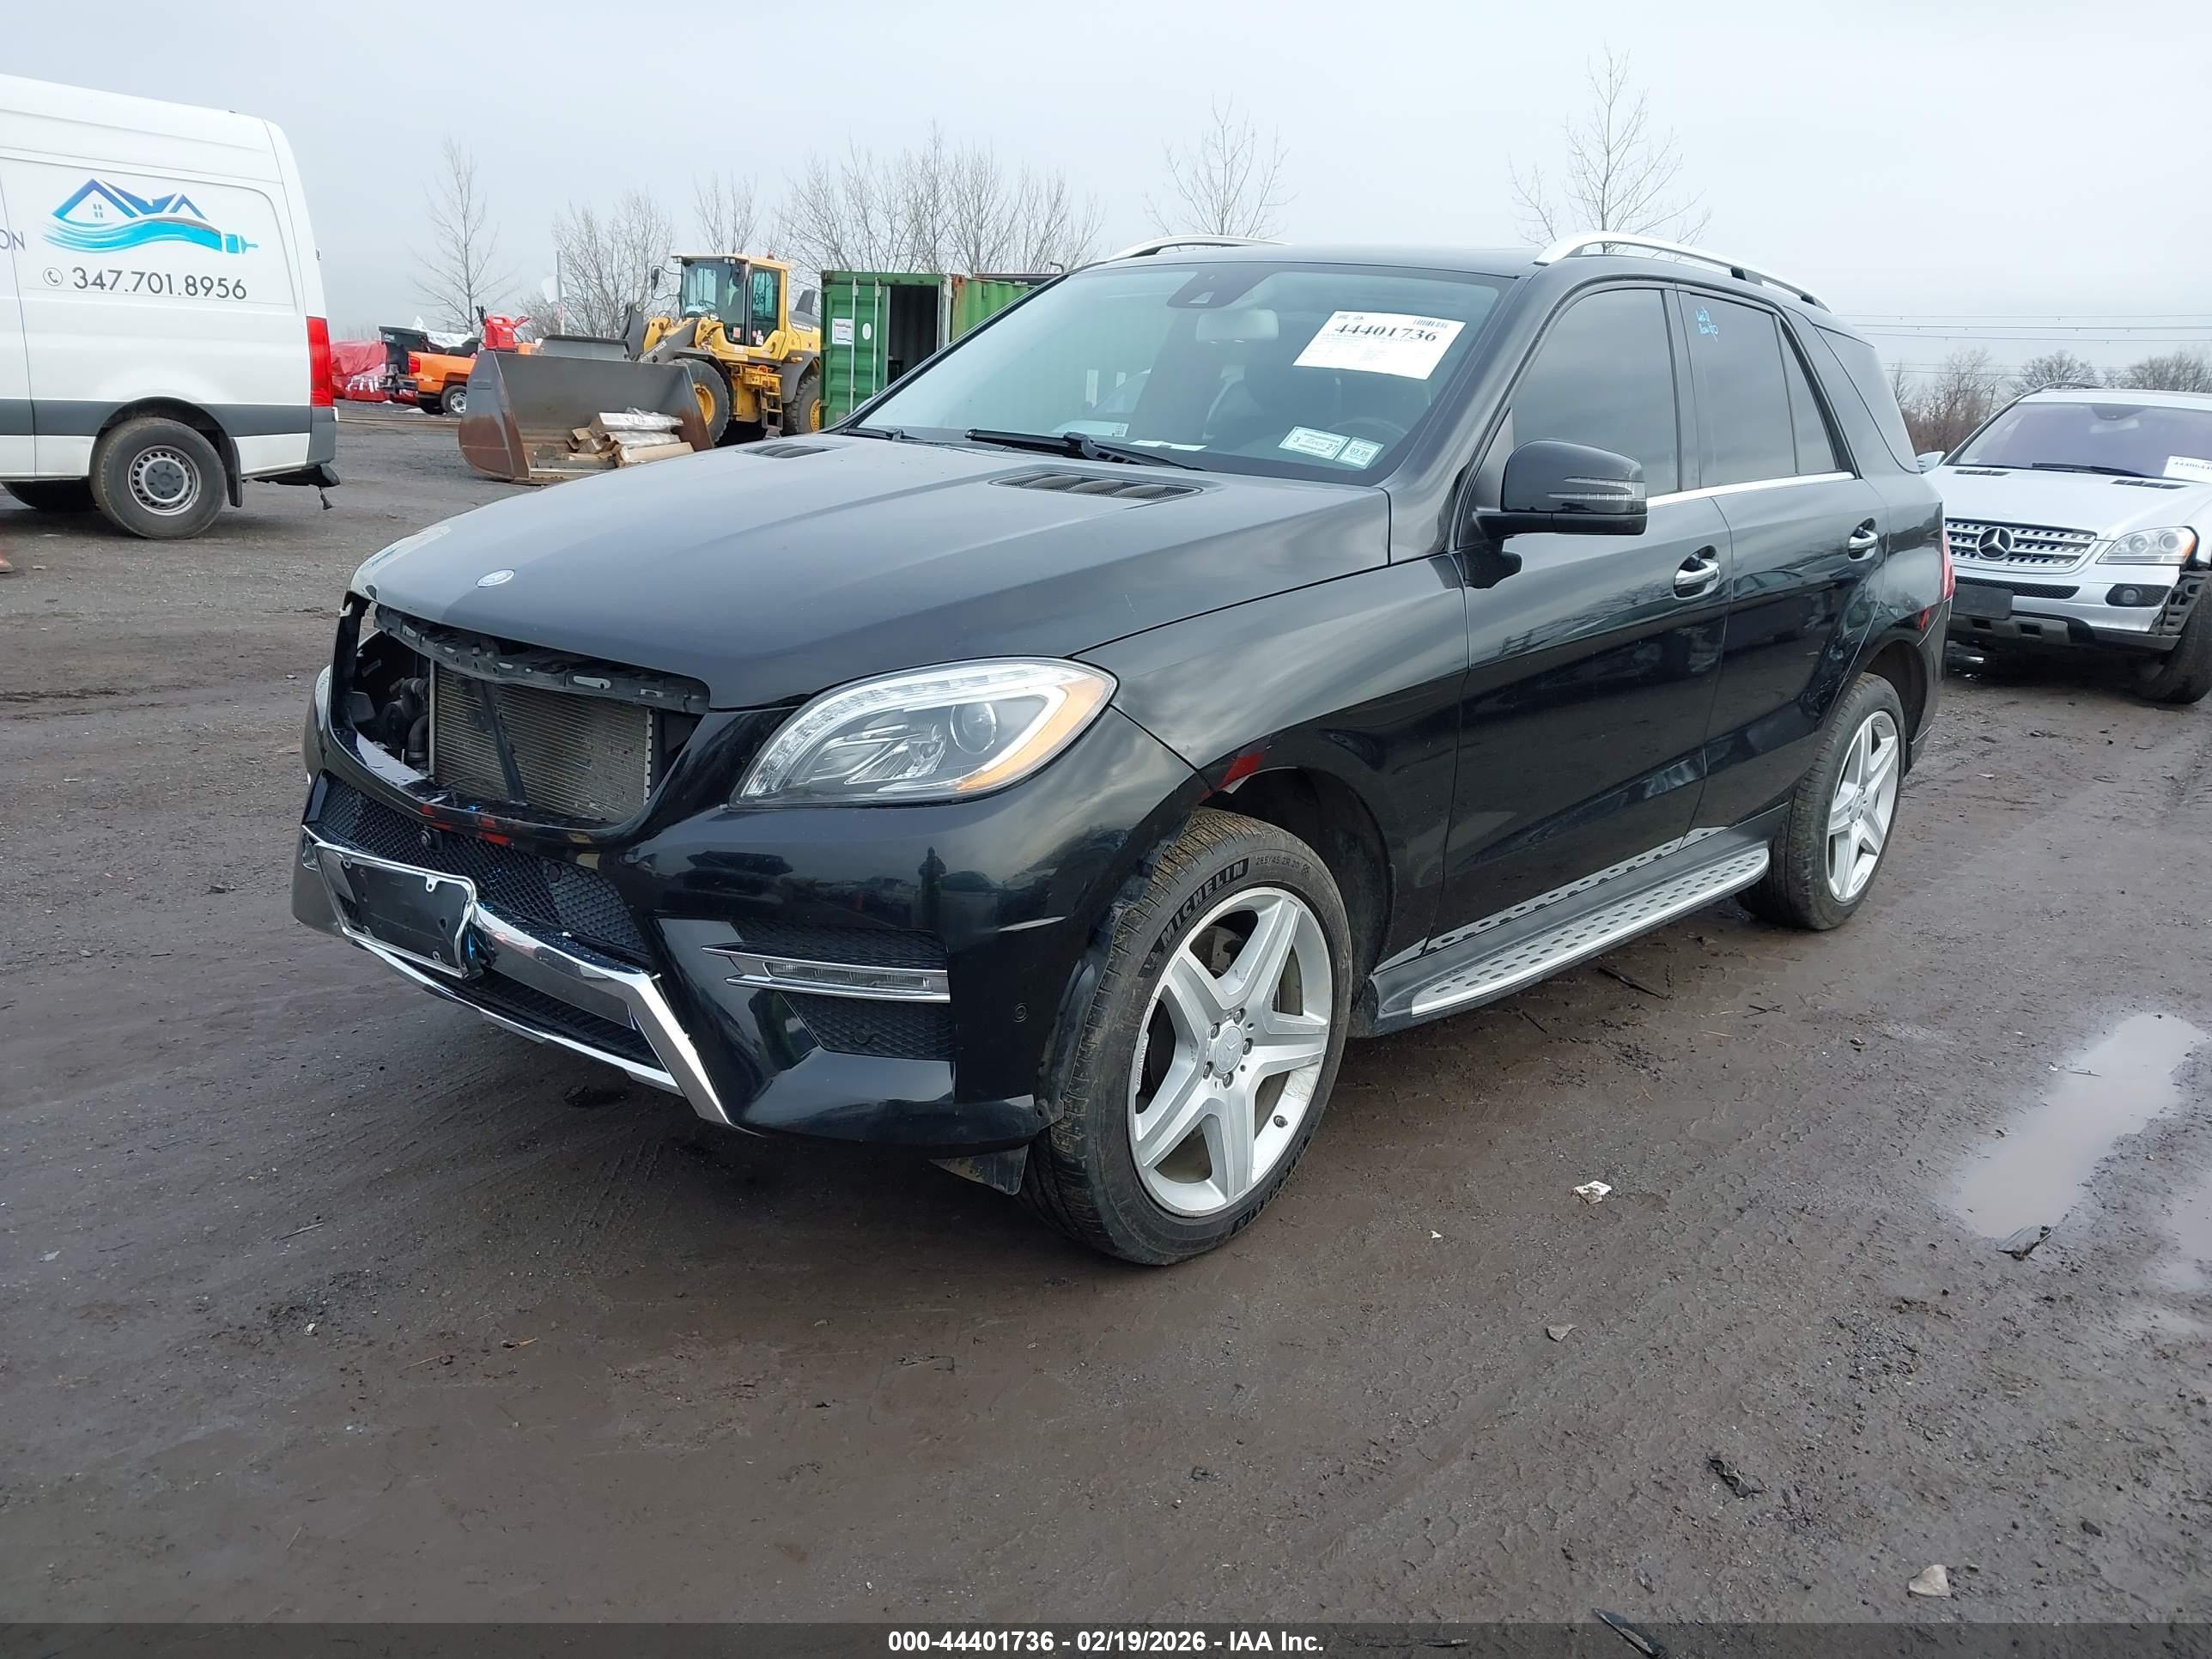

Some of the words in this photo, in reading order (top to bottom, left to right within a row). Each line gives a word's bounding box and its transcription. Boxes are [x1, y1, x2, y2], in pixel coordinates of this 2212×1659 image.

[73, 267, 246, 300] 347.701.8956
[1334, 323, 1442, 343] 44401736
[1159, 860, 1246, 945] MICHELIN
